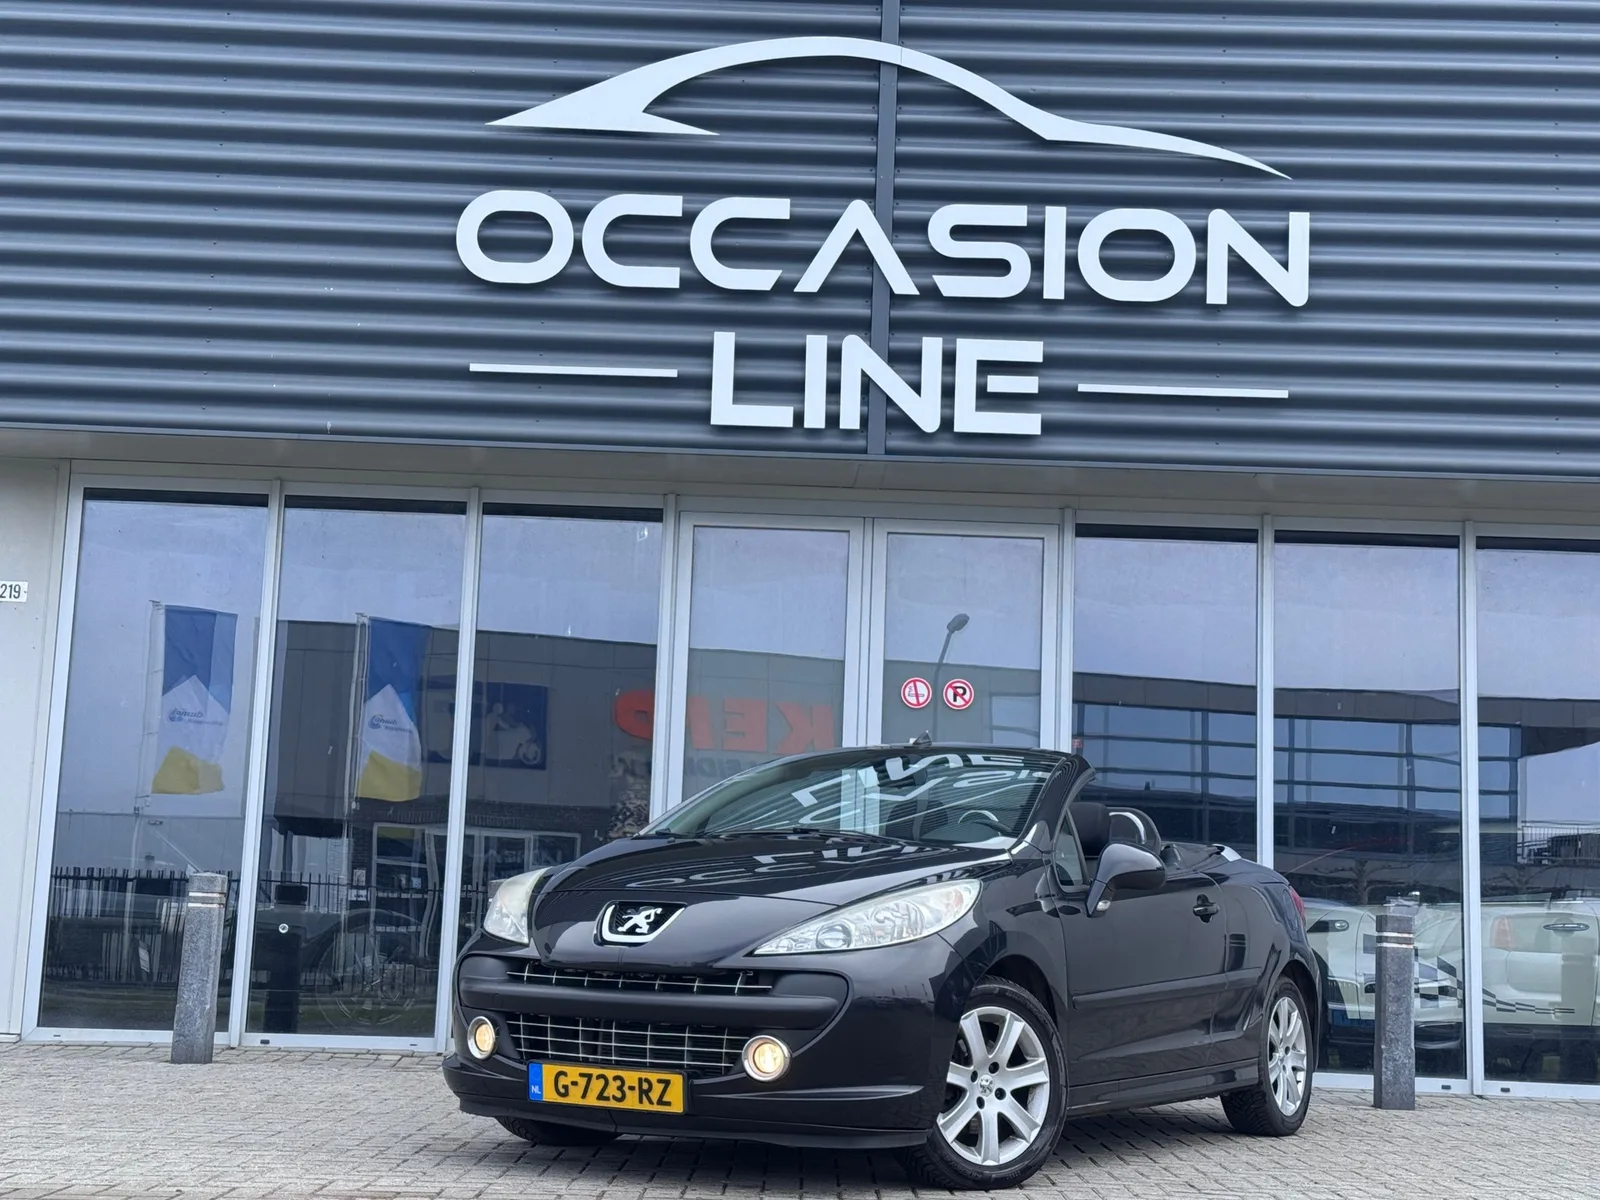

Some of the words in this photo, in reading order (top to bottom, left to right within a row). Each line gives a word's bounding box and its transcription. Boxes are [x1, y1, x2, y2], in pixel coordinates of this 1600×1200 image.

[456, 190, 1310, 307] OCCASION
[710, 331, 1044, 435] LINE
[0, 583, 21, 599] 219
[531, 1084, 542, 1095] NL
[553, 1070, 672, 1107] G-723-RZ
